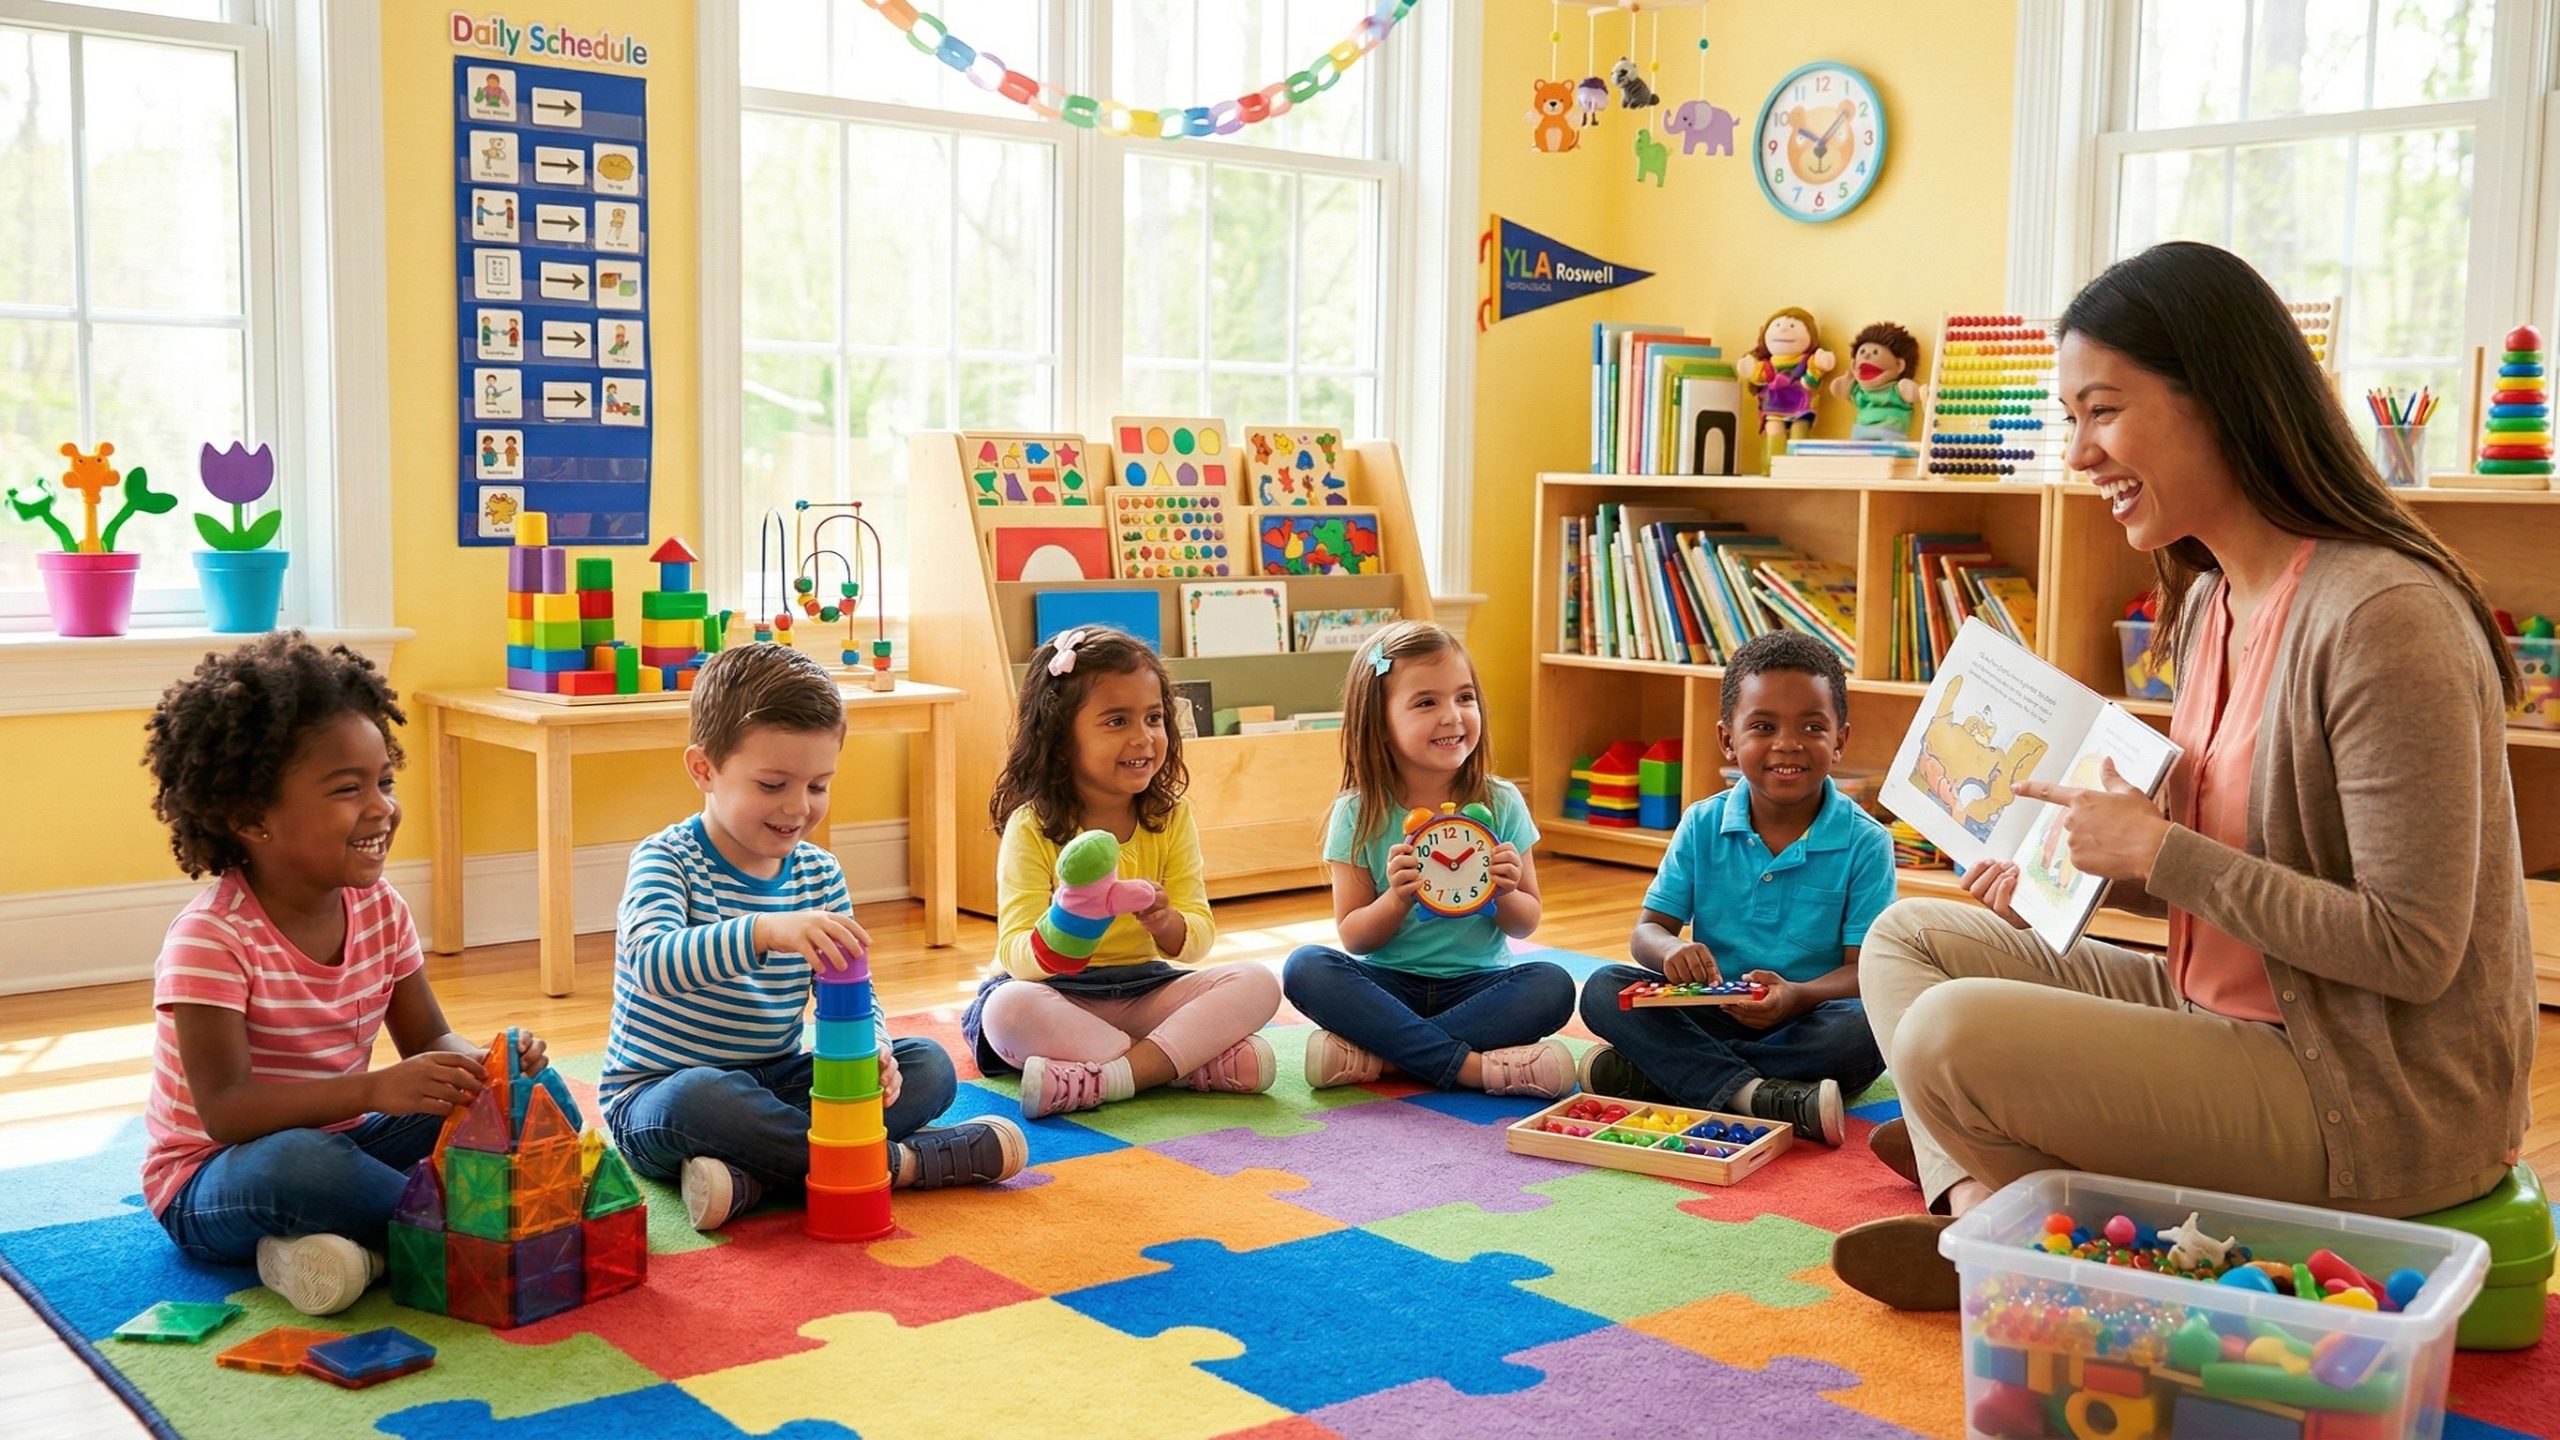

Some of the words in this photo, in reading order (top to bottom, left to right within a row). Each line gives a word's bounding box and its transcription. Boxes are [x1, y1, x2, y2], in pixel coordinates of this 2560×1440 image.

[453, 15, 521, 56] Daily
[529, 25, 648, 65] Schedule
[1815, 76, 1831, 93] 12
[1794, 86, 1806, 101] 11
[1858, 101, 1868, 117] 2
[1773, 111, 1789, 127] 10
[1864, 130, 1873, 146] 3
[1768, 140, 1778, 156] 9
[1855, 160, 1866, 176] 4
[1774, 168, 1784, 184] 8
[1793, 187, 1803, 204] 7
[1838, 182, 1848, 199] 5
[1814, 191, 1824, 207] 6
[1503, 247, 1553, 281] YLA
[1556, 262, 1614, 284] Roswell
[1428, 833, 1439, 845] 11
[1442, 827, 1457, 839] 12
[1464, 830, 1470, 842] 1
[1416, 845, 1430, 858] 10
[1476, 840, 1485, 852] 2
[1482, 856, 1490, 867] 3
[1480, 872, 1488, 884] 4
[1423, 880, 1432, 892] 8
[1470, 886, 1478, 898] 5
[1436, 889, 1445, 901] 7
[1453, 892, 1461, 903] 6
